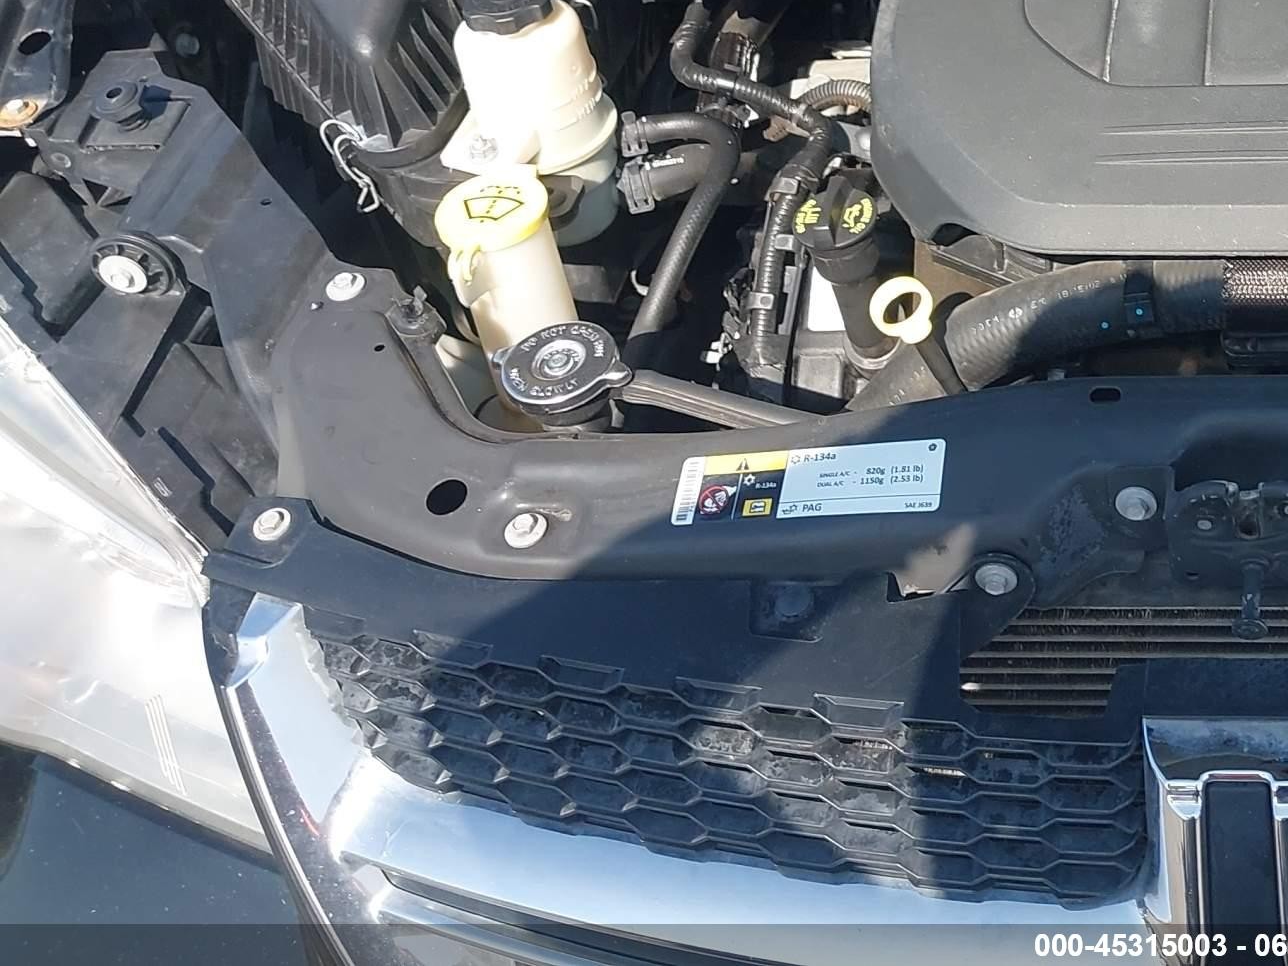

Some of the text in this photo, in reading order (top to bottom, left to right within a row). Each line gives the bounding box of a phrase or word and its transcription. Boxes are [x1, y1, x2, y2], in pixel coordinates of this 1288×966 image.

[803, 452, 837, 463] R-134a
[866, 467, 886, 476] 820g
[890, 464, 911, 474] (1.81
[913, 464, 924, 473] lb)
[860, 476, 884, 485] 1150g
[890, 474, 911, 484] (2.53
[913, 474, 924, 483] lb)
[802, 502, 823, 512] PAG
